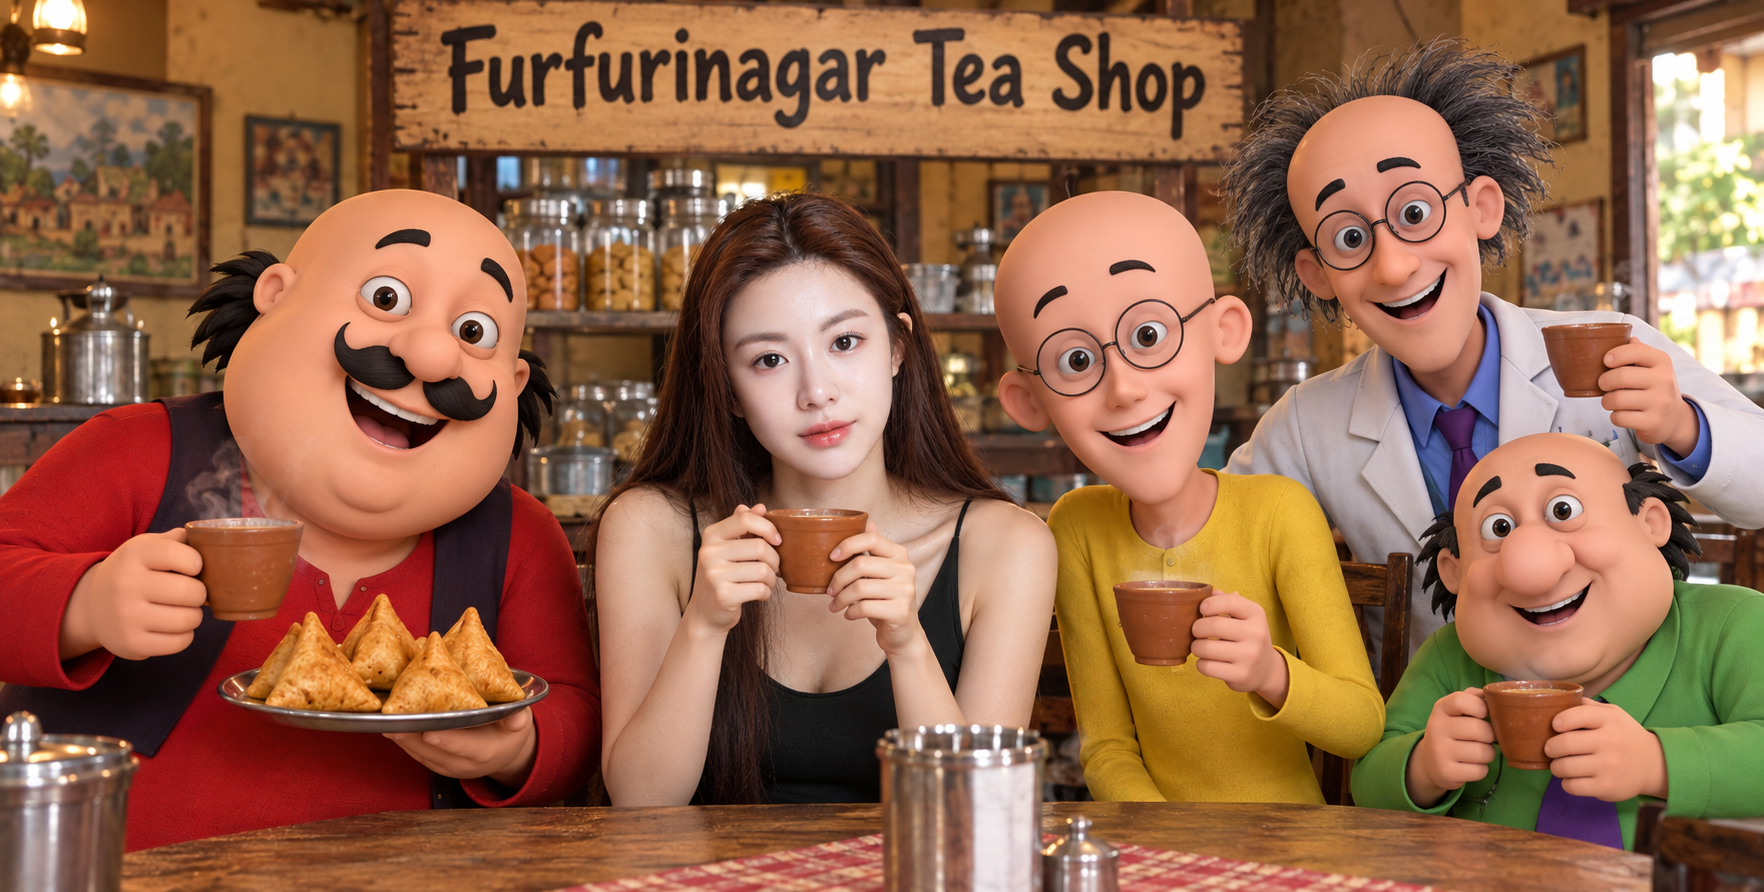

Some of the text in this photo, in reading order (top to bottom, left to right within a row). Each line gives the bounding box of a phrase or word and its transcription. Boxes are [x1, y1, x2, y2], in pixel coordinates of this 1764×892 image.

[440, 21, 1207, 141] Furfurinagar Tea Shop
